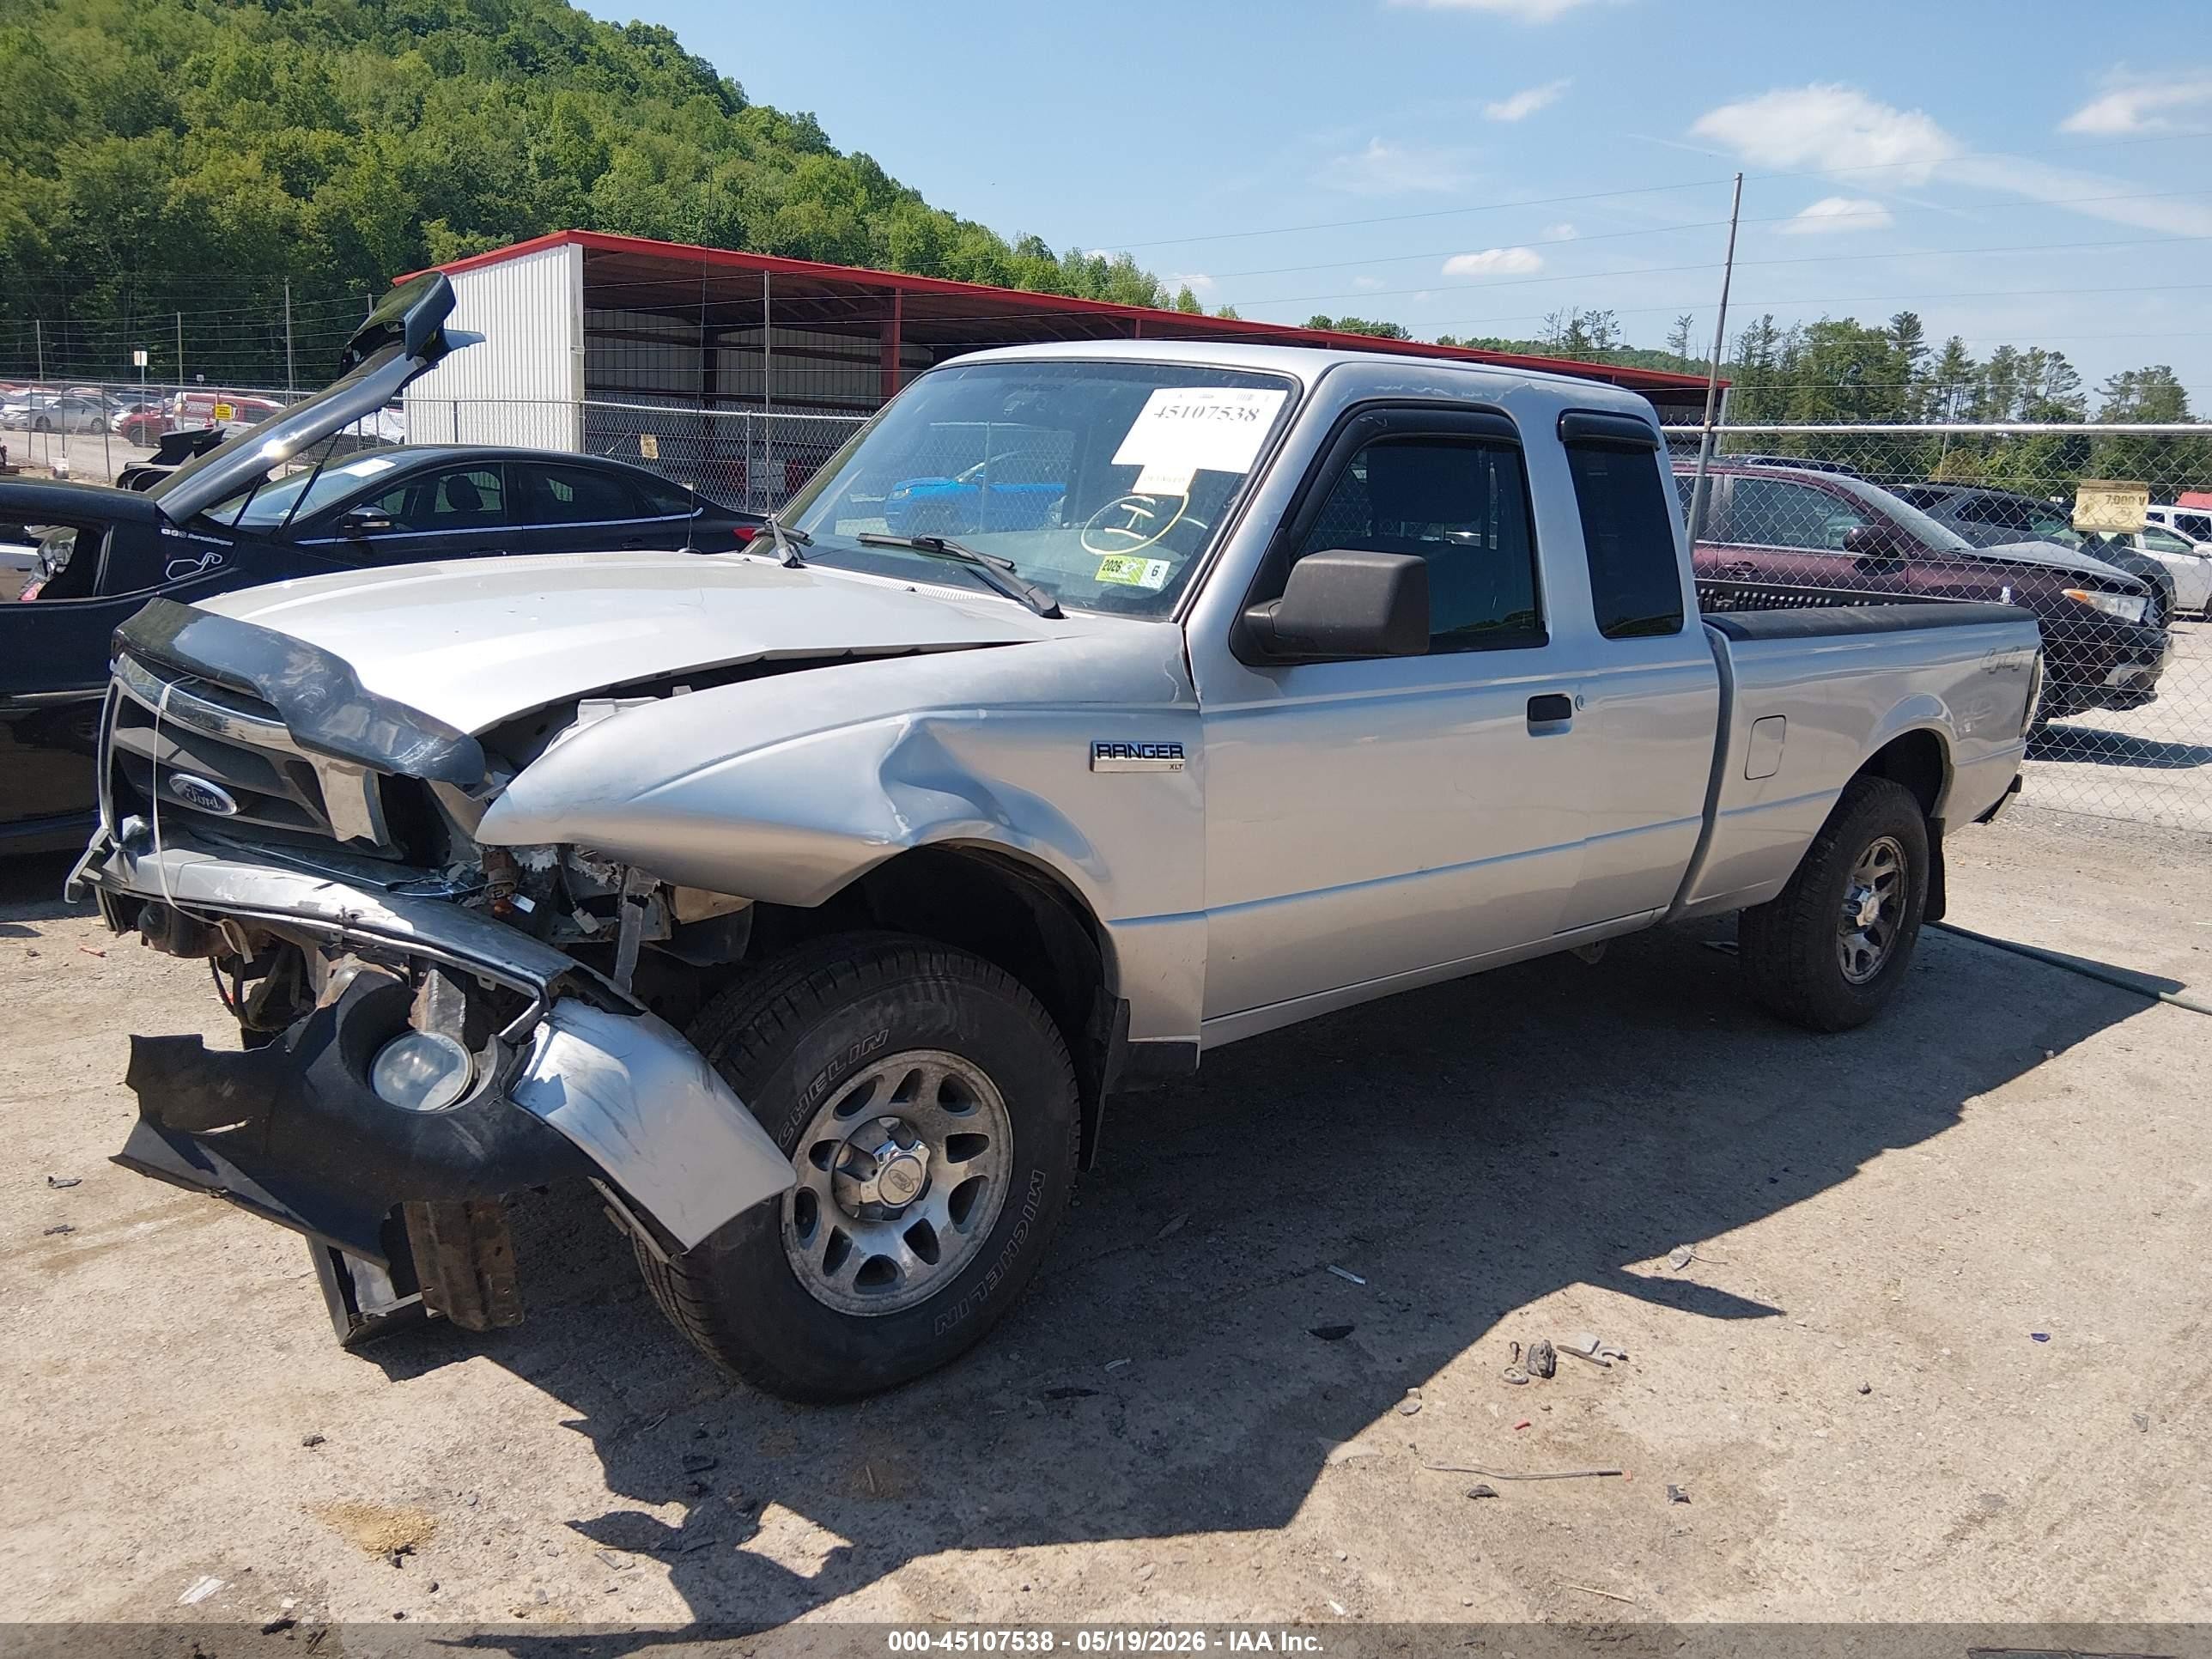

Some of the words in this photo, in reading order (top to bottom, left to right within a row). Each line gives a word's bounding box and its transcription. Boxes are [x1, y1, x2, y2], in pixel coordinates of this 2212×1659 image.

[1154, 405, 1260, 422] 45107538
[2106, 495, 2136, 507] 7,000
[2139, 496, 2146, 507] V
[1101, 559, 1123, 573] 2026
[1152, 565, 1160, 577] 6
[1096, 743, 1185, 760] RANGER
[184, 781, 222, 811] Ford
[777, 1029, 890, 1149] CHELIN
[933, 1168, 1047, 1337] MICHELIN
